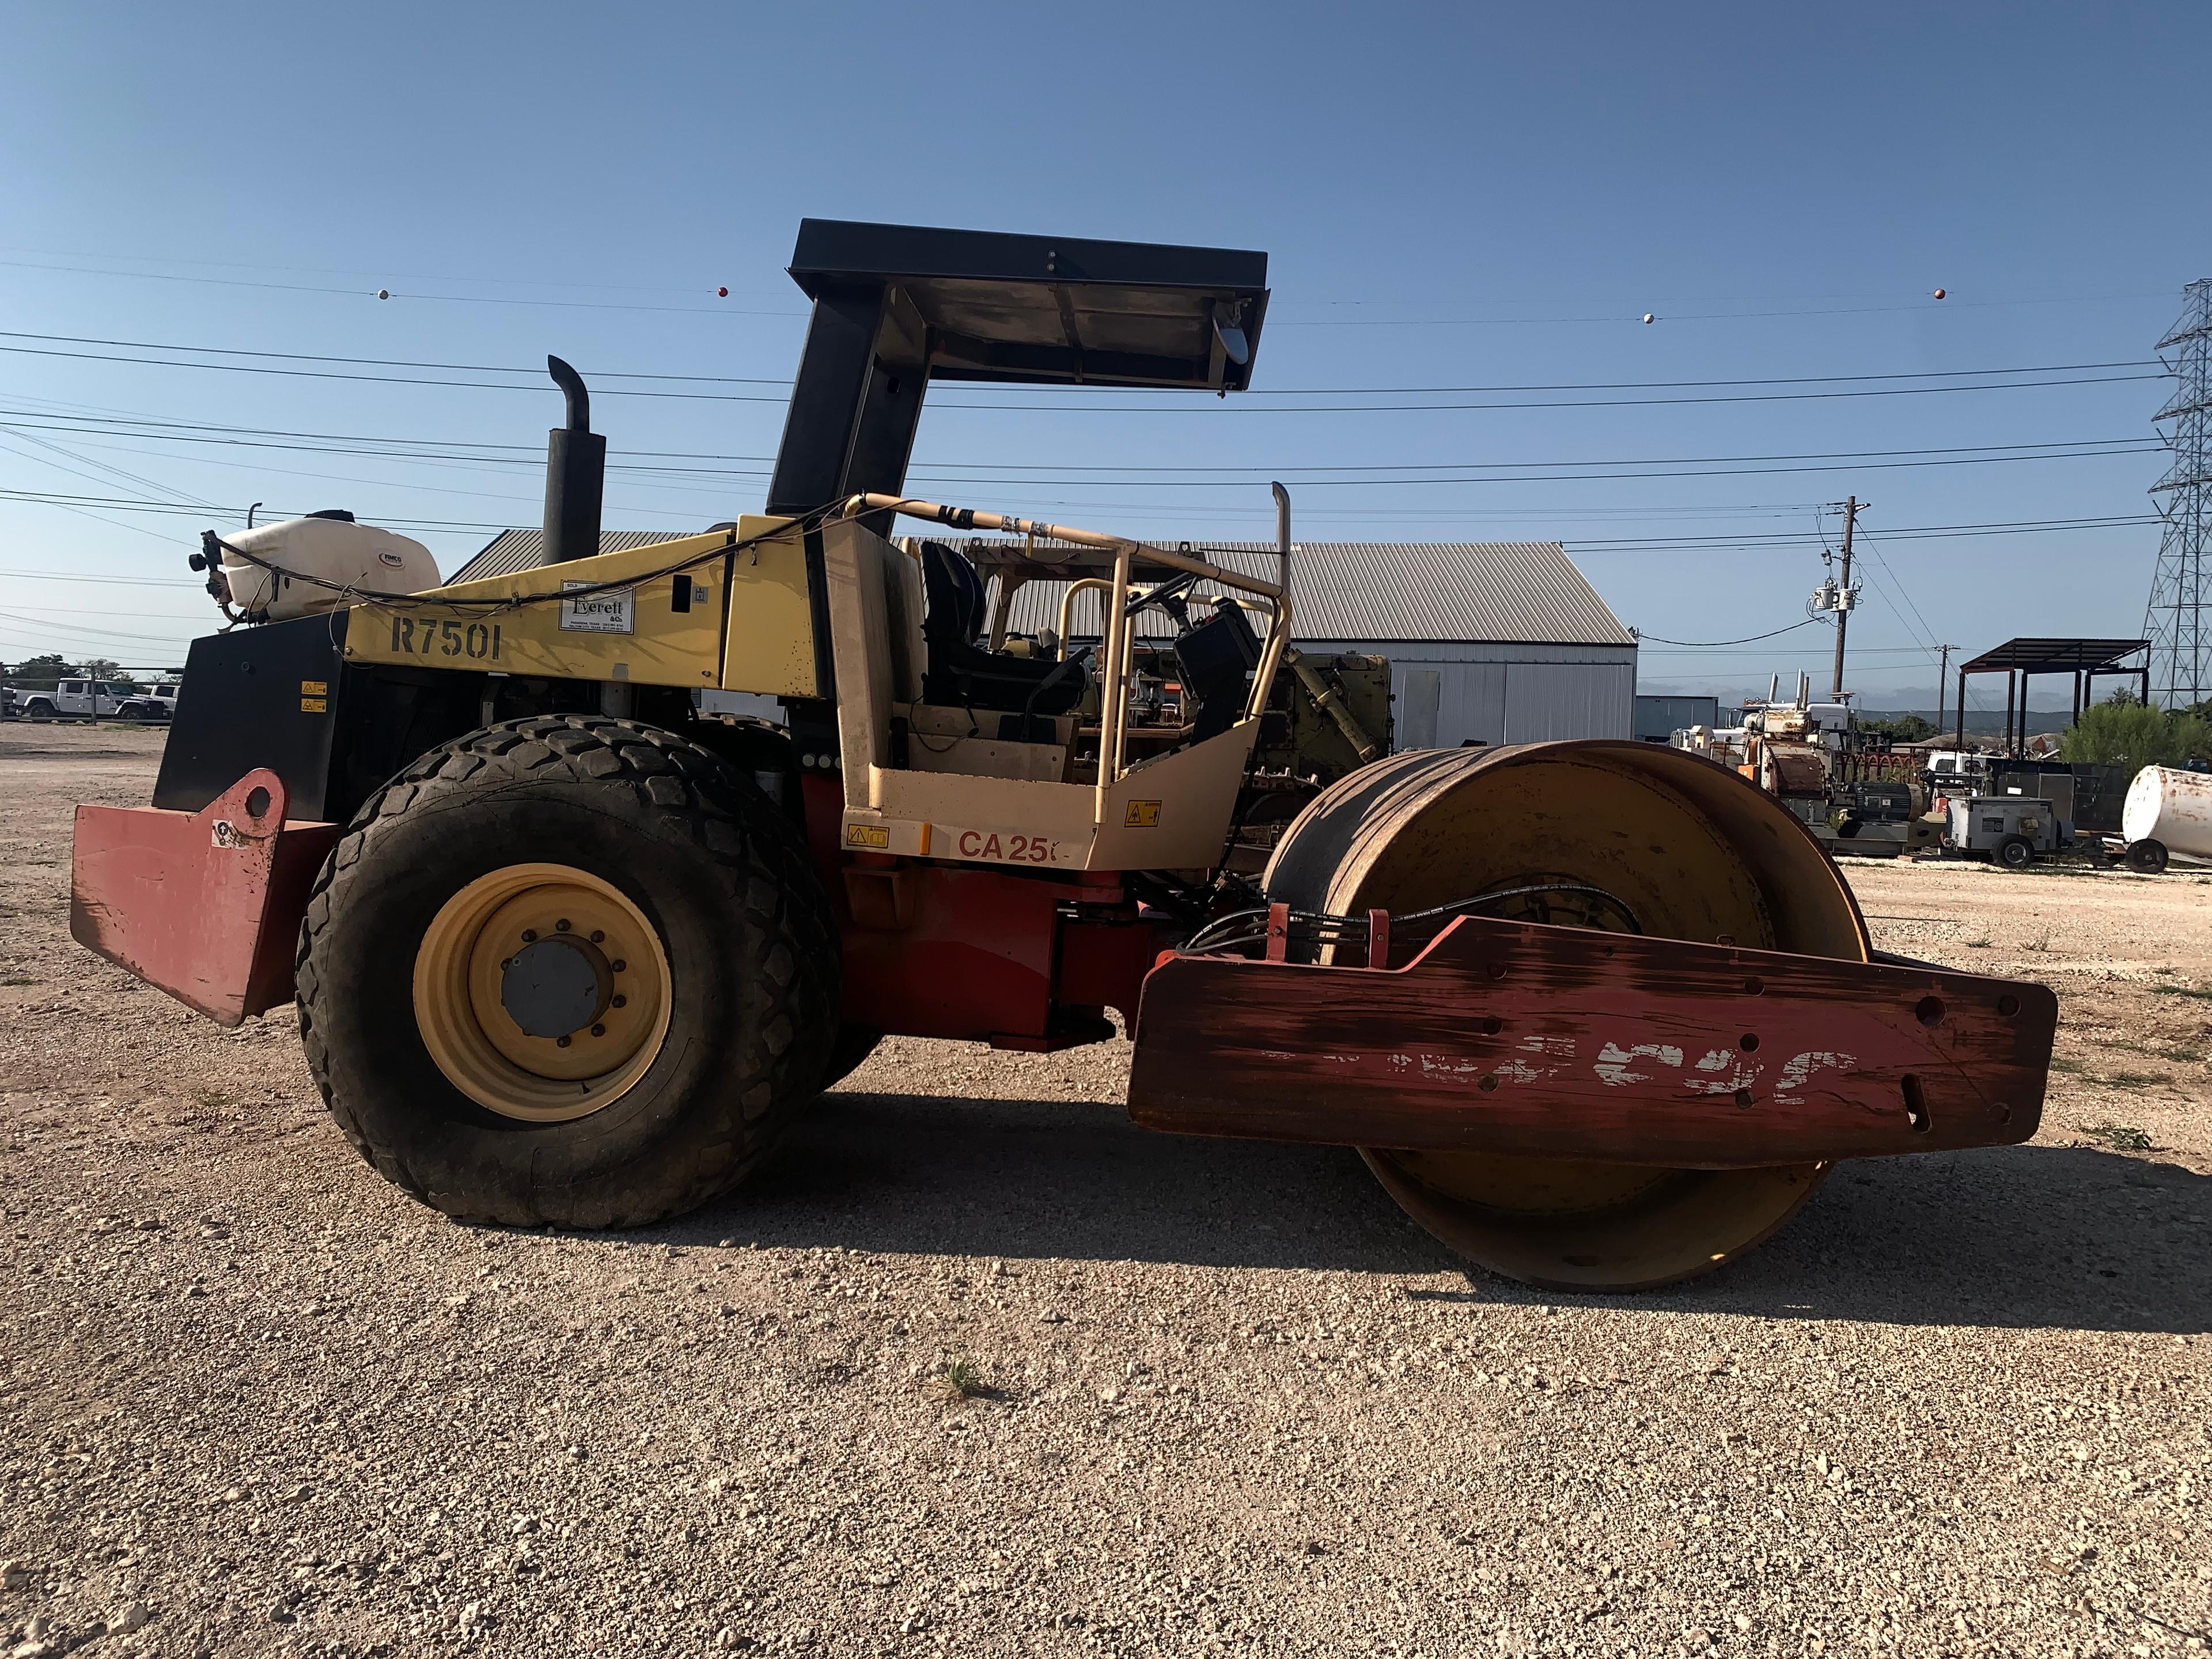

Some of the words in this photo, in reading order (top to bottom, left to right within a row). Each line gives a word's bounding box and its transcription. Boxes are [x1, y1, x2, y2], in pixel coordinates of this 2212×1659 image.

[573, 596, 623, 615] Everett
[959, 831, 1003, 859] CA
[1009, 835, 1069, 863] 25
